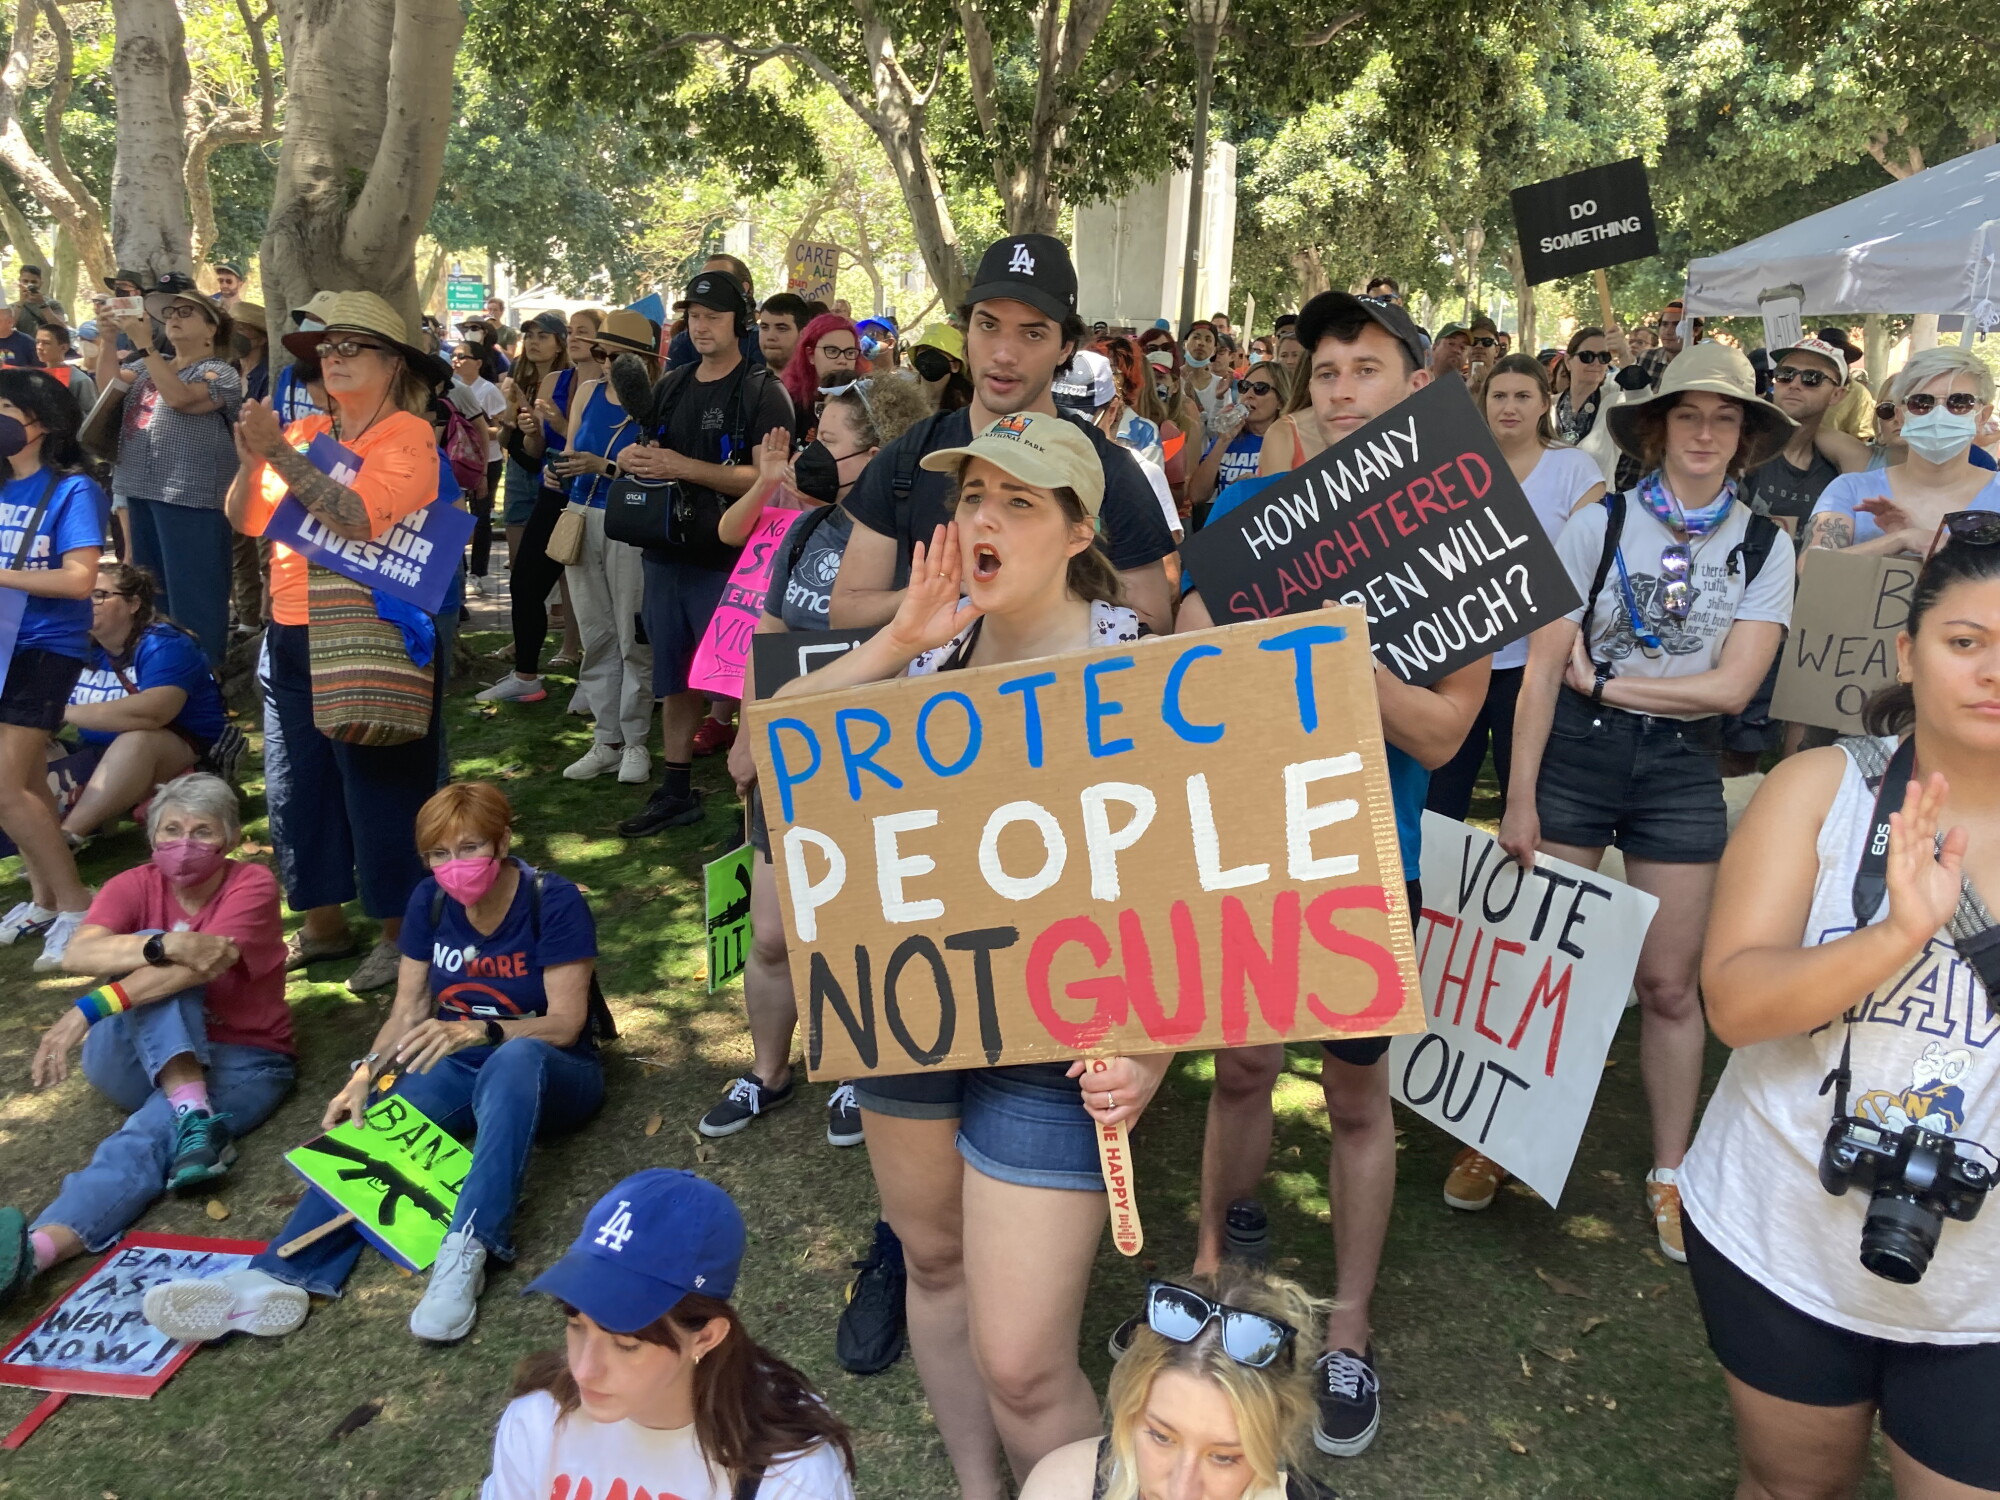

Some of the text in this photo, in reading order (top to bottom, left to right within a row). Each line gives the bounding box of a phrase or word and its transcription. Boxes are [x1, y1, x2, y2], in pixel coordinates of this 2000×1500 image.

[1569, 200, 1597, 220] DO
[1540, 216, 1641, 253] SOMETHING
[795, 244, 836, 267] CARE
[795, 262, 835, 279] 4 ALL
[1008, 243, 1035, 276] LA
[788, 278, 808, 289] gun
[985, 432, 1021, 446] NATIONAL
[1024, 438, 1046, 454] PARK
[626, 493, 642, 501] ORCA
[1241, 415, 1419, 560] HOW MANY
[297, 511, 381, 571] LIVES
[763, 519, 785, 537] No
[1229, 452, 1492, 619] SLAUGHTERED
[1418, 506, 1529, 581] WILL
[767, 626, 1348, 823] PROTECT
[783, 752, 1363, 942] PEOPLE
[1871, 823, 1891, 855] EOS
[1459, 834, 1612, 959] VOTE
[433, 942, 528, 978] NO MORE
[808, 884, 1408, 1071] NOT GUNS
[1419, 907, 1573, 1078] THEM
[1403, 1033, 1531, 1144] OUT
[1905, 1092, 1933, 1119] N
[362, 1099, 464, 1171] BAN
[1106, 1147, 1130, 1211] HAPPY
[594, 1200, 634, 1252] LA
[113, 1248, 214, 1271] BAN
[41, 1306, 151, 1337] WEAP
[8, 1338, 179, 1372] NOW!
